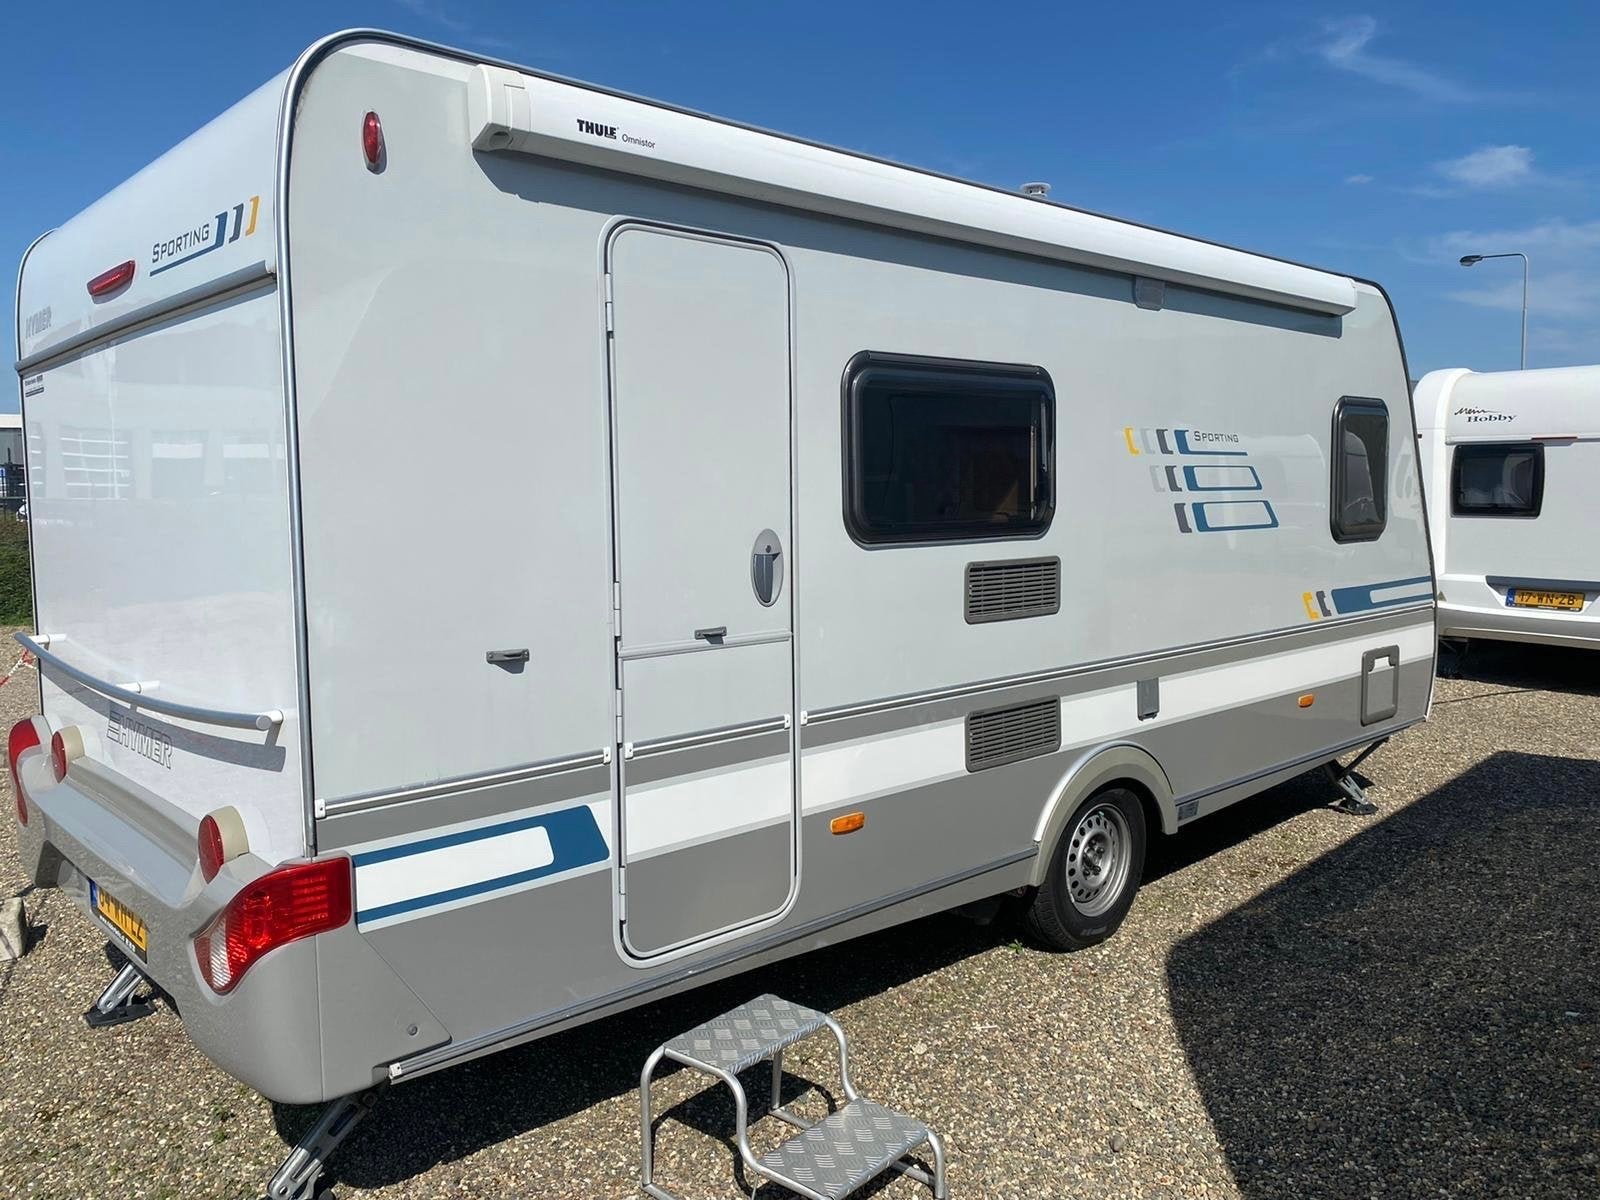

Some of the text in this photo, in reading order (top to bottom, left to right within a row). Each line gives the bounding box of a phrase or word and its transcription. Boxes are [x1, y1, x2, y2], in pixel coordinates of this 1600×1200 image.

[576, 118, 657, 149] THULE Omnistor
[151, 222, 211, 264] SPORTING
[1467, 413, 1518, 424] Hobby
[1193, 430, 1240, 444] SPORTING
